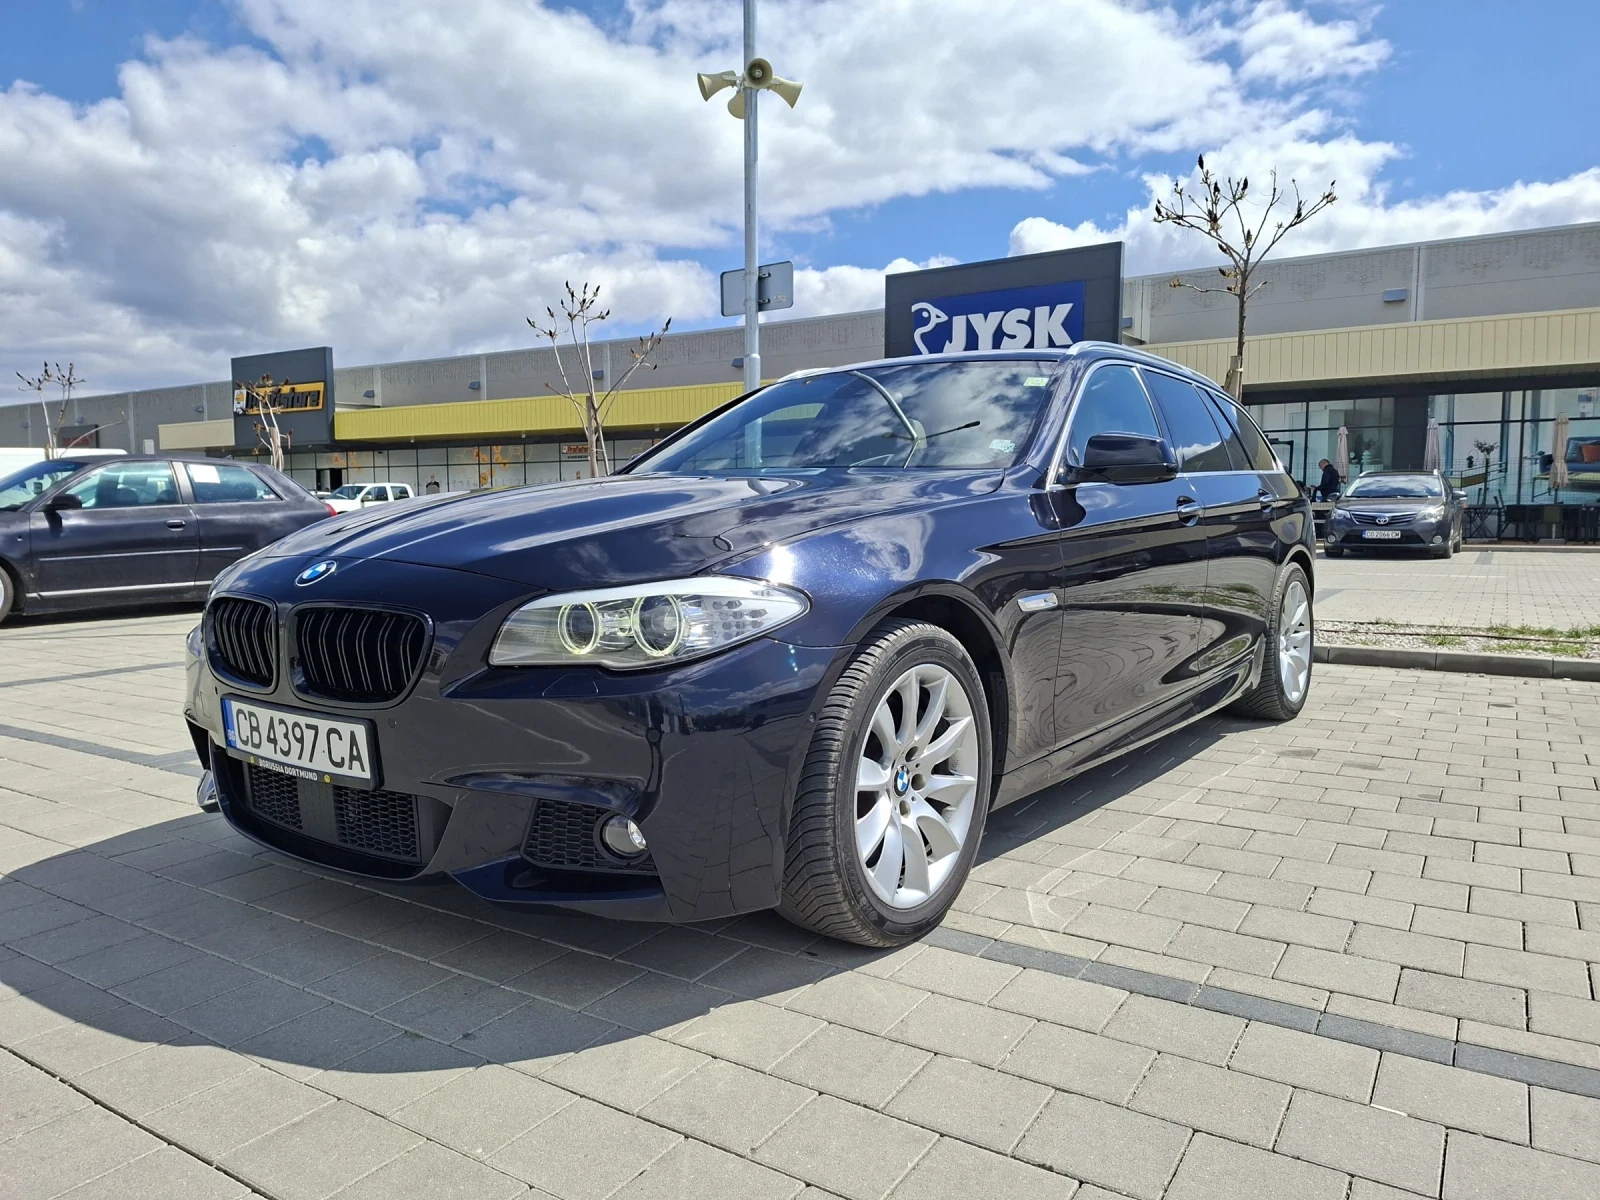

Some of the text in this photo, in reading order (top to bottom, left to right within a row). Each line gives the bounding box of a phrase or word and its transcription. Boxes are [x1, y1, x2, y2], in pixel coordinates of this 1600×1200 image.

[942, 303, 1074, 352] JYSK
[227, 729, 236, 741] BG
[236, 708, 366, 772] CB 4397 CA
[259, 758, 318, 780] BORUSSIA DORTMUND
